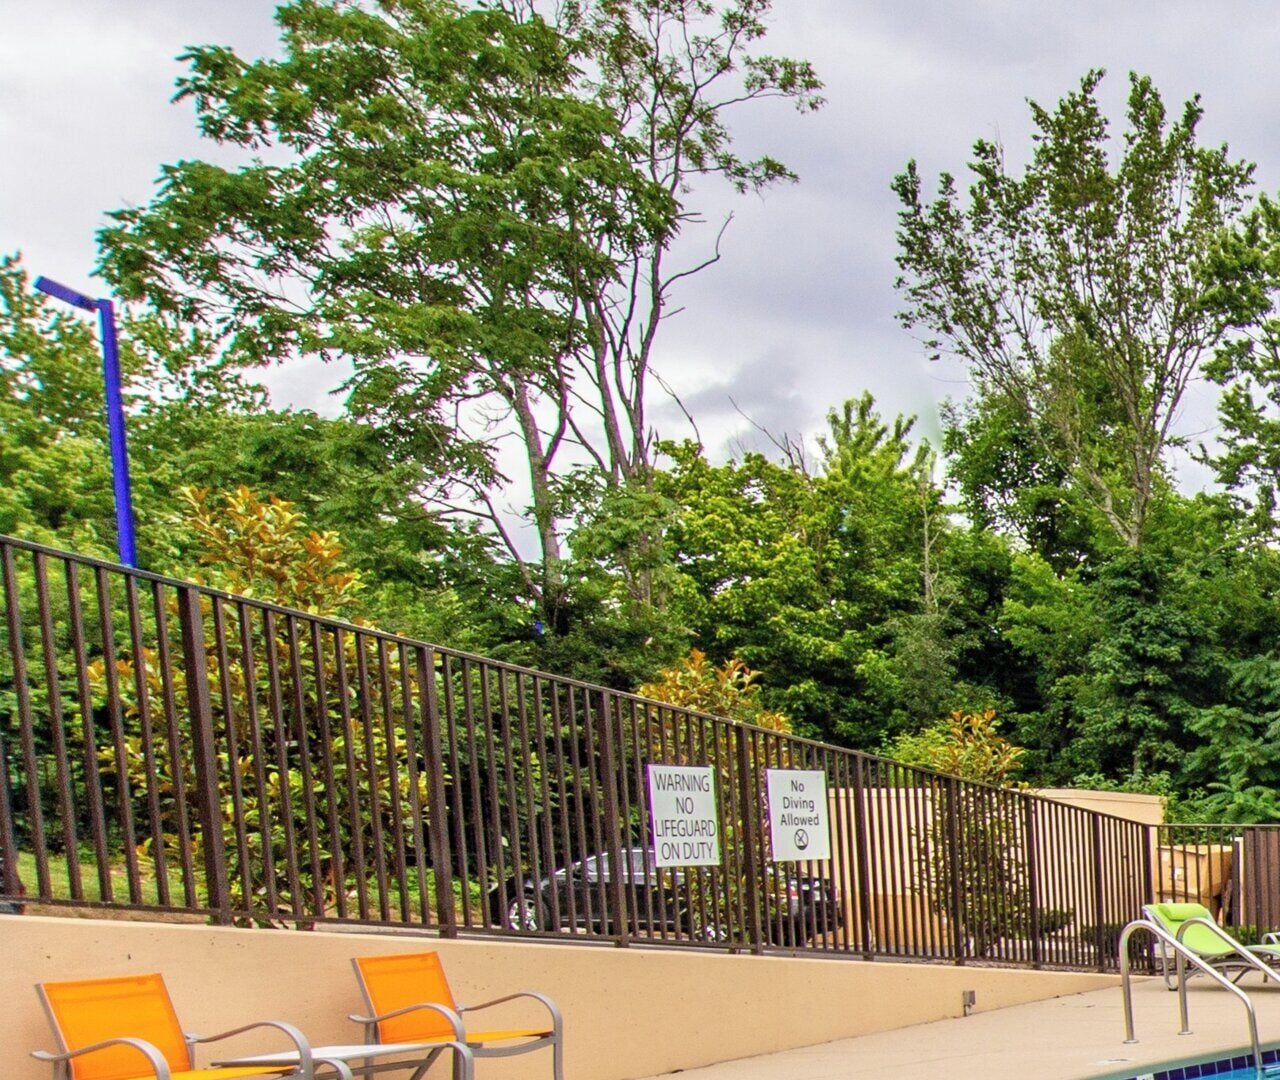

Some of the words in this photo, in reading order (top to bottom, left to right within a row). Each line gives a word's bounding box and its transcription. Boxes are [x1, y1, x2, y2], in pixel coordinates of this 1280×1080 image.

[654, 771, 710, 792] WARNING
[790, 780, 805, 792] No
[676, 797, 694, 814] NO
[782, 796, 815, 812] Diving
[655, 820, 717, 837] LIFEGUARD
[780, 814, 820, 826] Allowed
[661, 842, 680, 860] ON
[683, 842, 713, 859] DUTY
